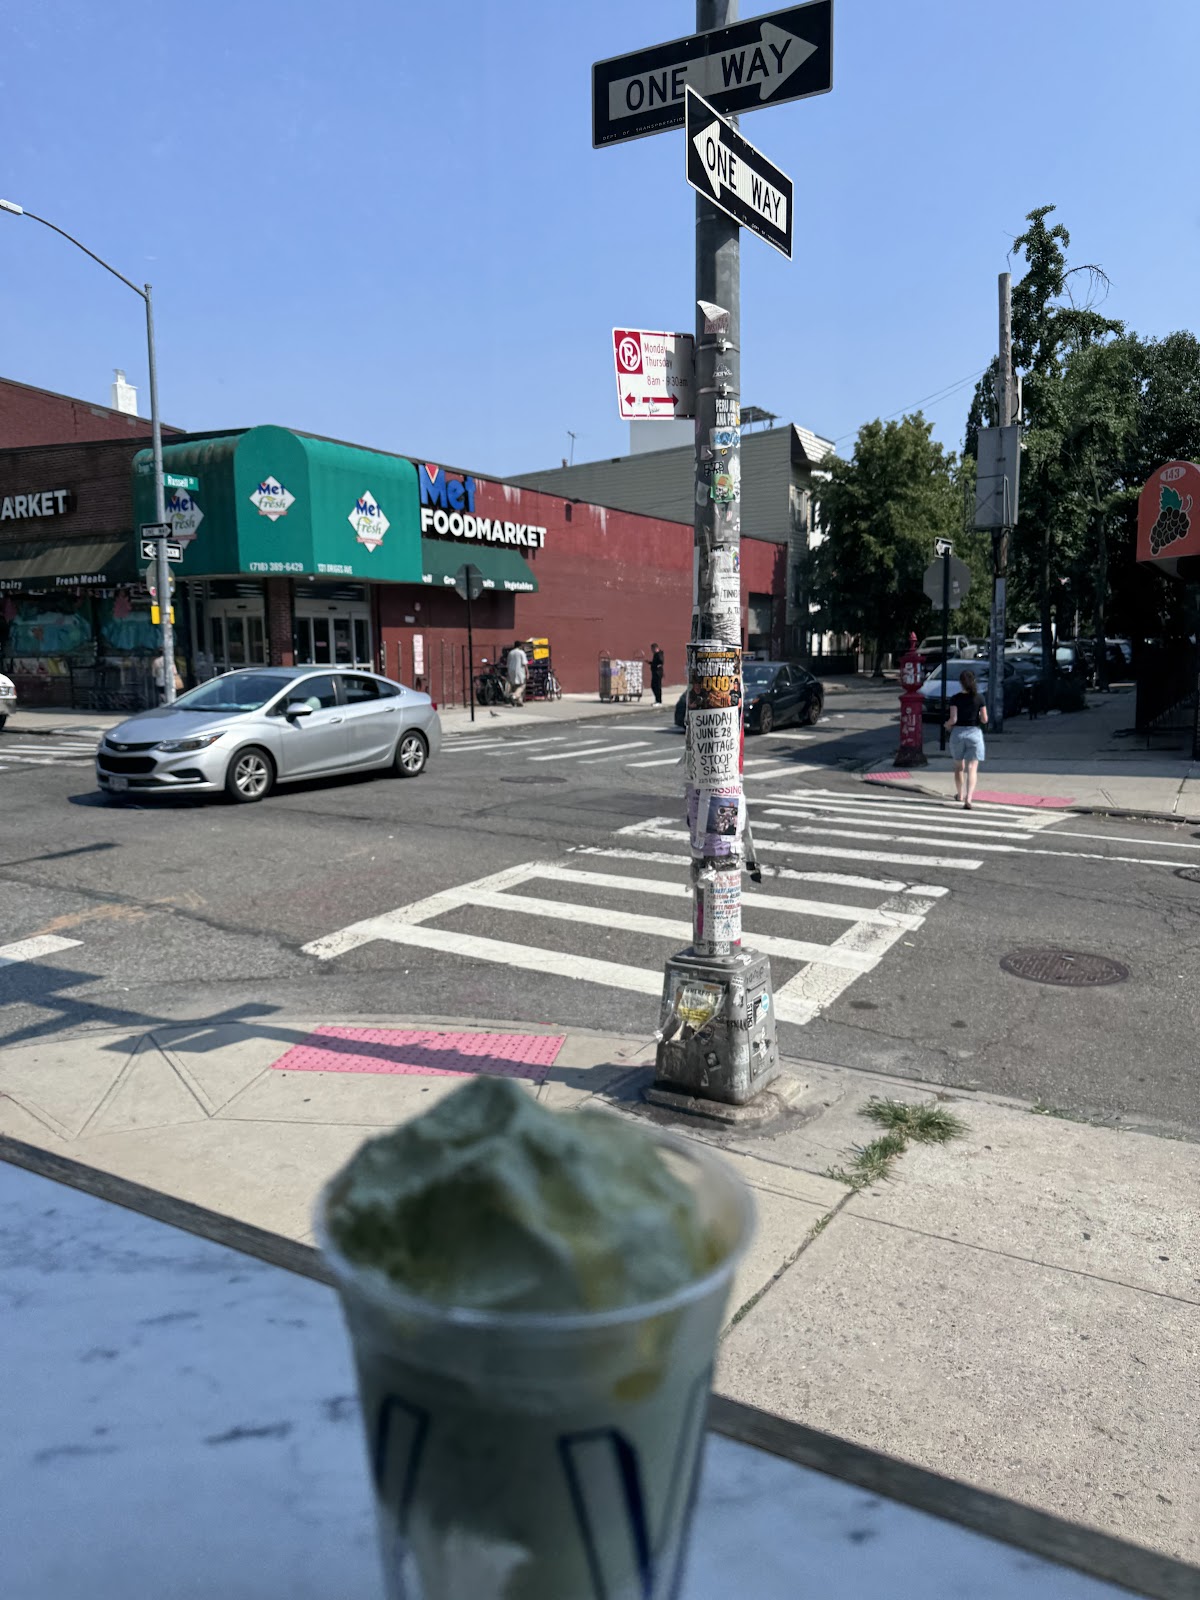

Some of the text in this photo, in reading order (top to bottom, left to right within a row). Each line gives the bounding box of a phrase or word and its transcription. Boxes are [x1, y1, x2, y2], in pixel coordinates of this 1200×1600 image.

[626, 38, 792, 111] ONE WAY
[602, 133, 617, 141] DEPT
[706, 136, 781, 223] ONE WAY
[644, 342, 667, 354] Monday
[645, 356, 672, 370] Thursday
[647, 375, 661, 386] 8am
[1164, 468, 1180, 480] 143
[257, 483, 285, 496] Met
[418, 464, 476, 513] Met
[0, 489, 68, 520] ARKET
[168, 496, 195, 513] Met
[258, 497, 286, 509] fresh
[356, 498, 381, 518] Met
[356, 517, 382, 535] fresh
[421, 507, 547, 548] FOODMARKET
[0, 580, 22, 590] Dairy
[56, 574, 107, 586] Fresh Meats
[504, 580, 534, 592] Vegetables
[703, 676, 730, 691] DUO
[696, 712, 732, 727] SUNDAY
[696, 727, 732, 739] JUNE 28
[697, 738, 735, 754] VINTAGE
[700, 753, 733, 766] STOOP
[703, 764, 731, 776] SALE
